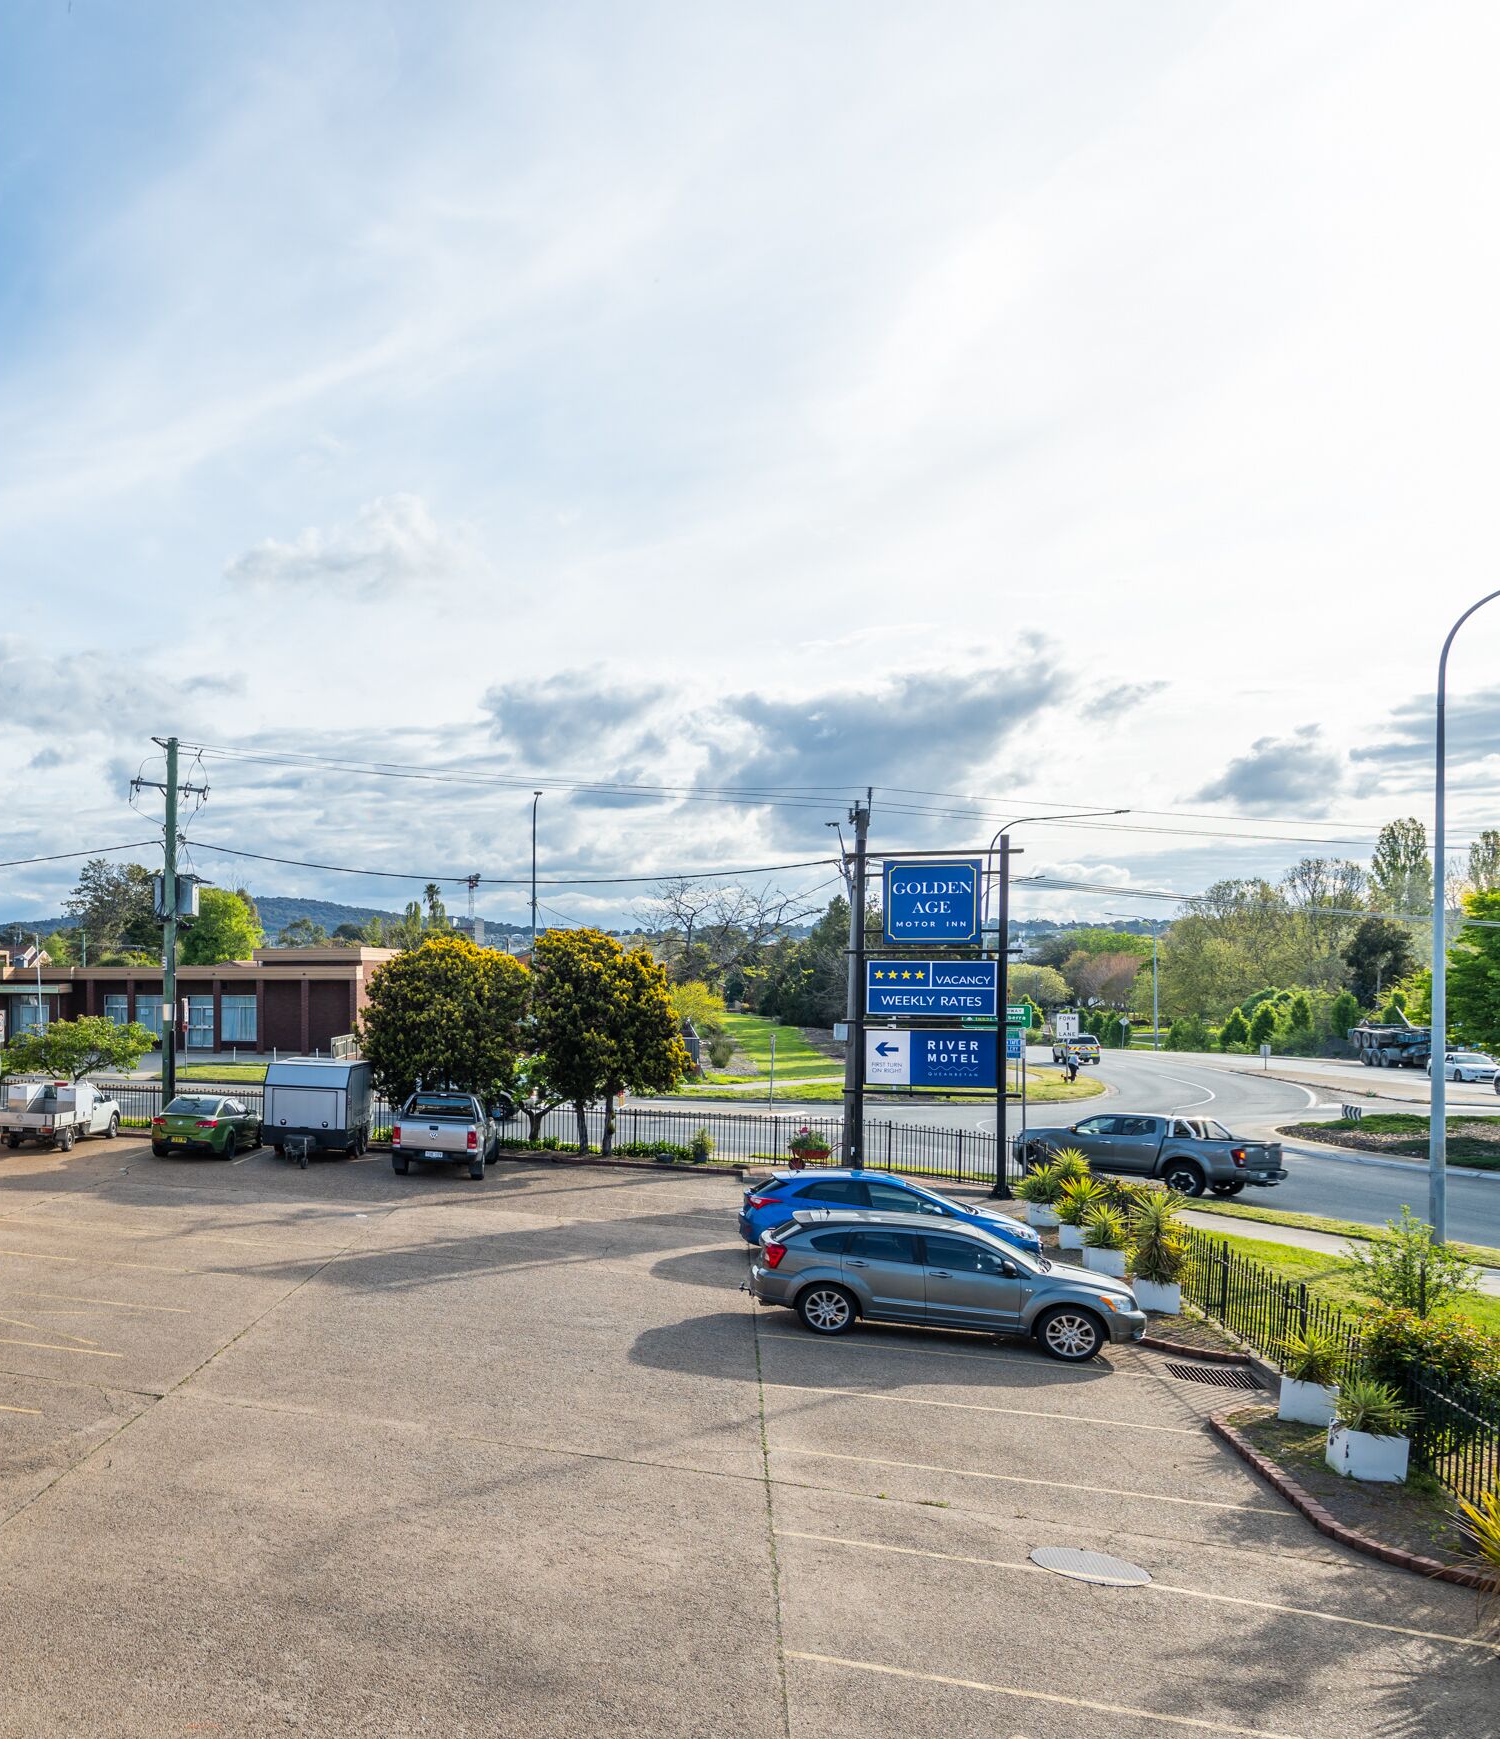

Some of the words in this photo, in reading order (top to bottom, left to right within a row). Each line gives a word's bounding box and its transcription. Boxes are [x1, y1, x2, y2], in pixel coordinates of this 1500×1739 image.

[892, 881, 973, 895] GOLDEN
[912, 901, 951, 914] AGE
[935, 975, 991, 985] VACANCY
[881, 995, 935, 1006] WEEKLY
[940, 996, 982, 1007] RATES
[1066, 1022, 1070, 1030] 1
[927, 1040, 979, 1051] RIVER
[927, 1053, 979, 1064] MOTEL
